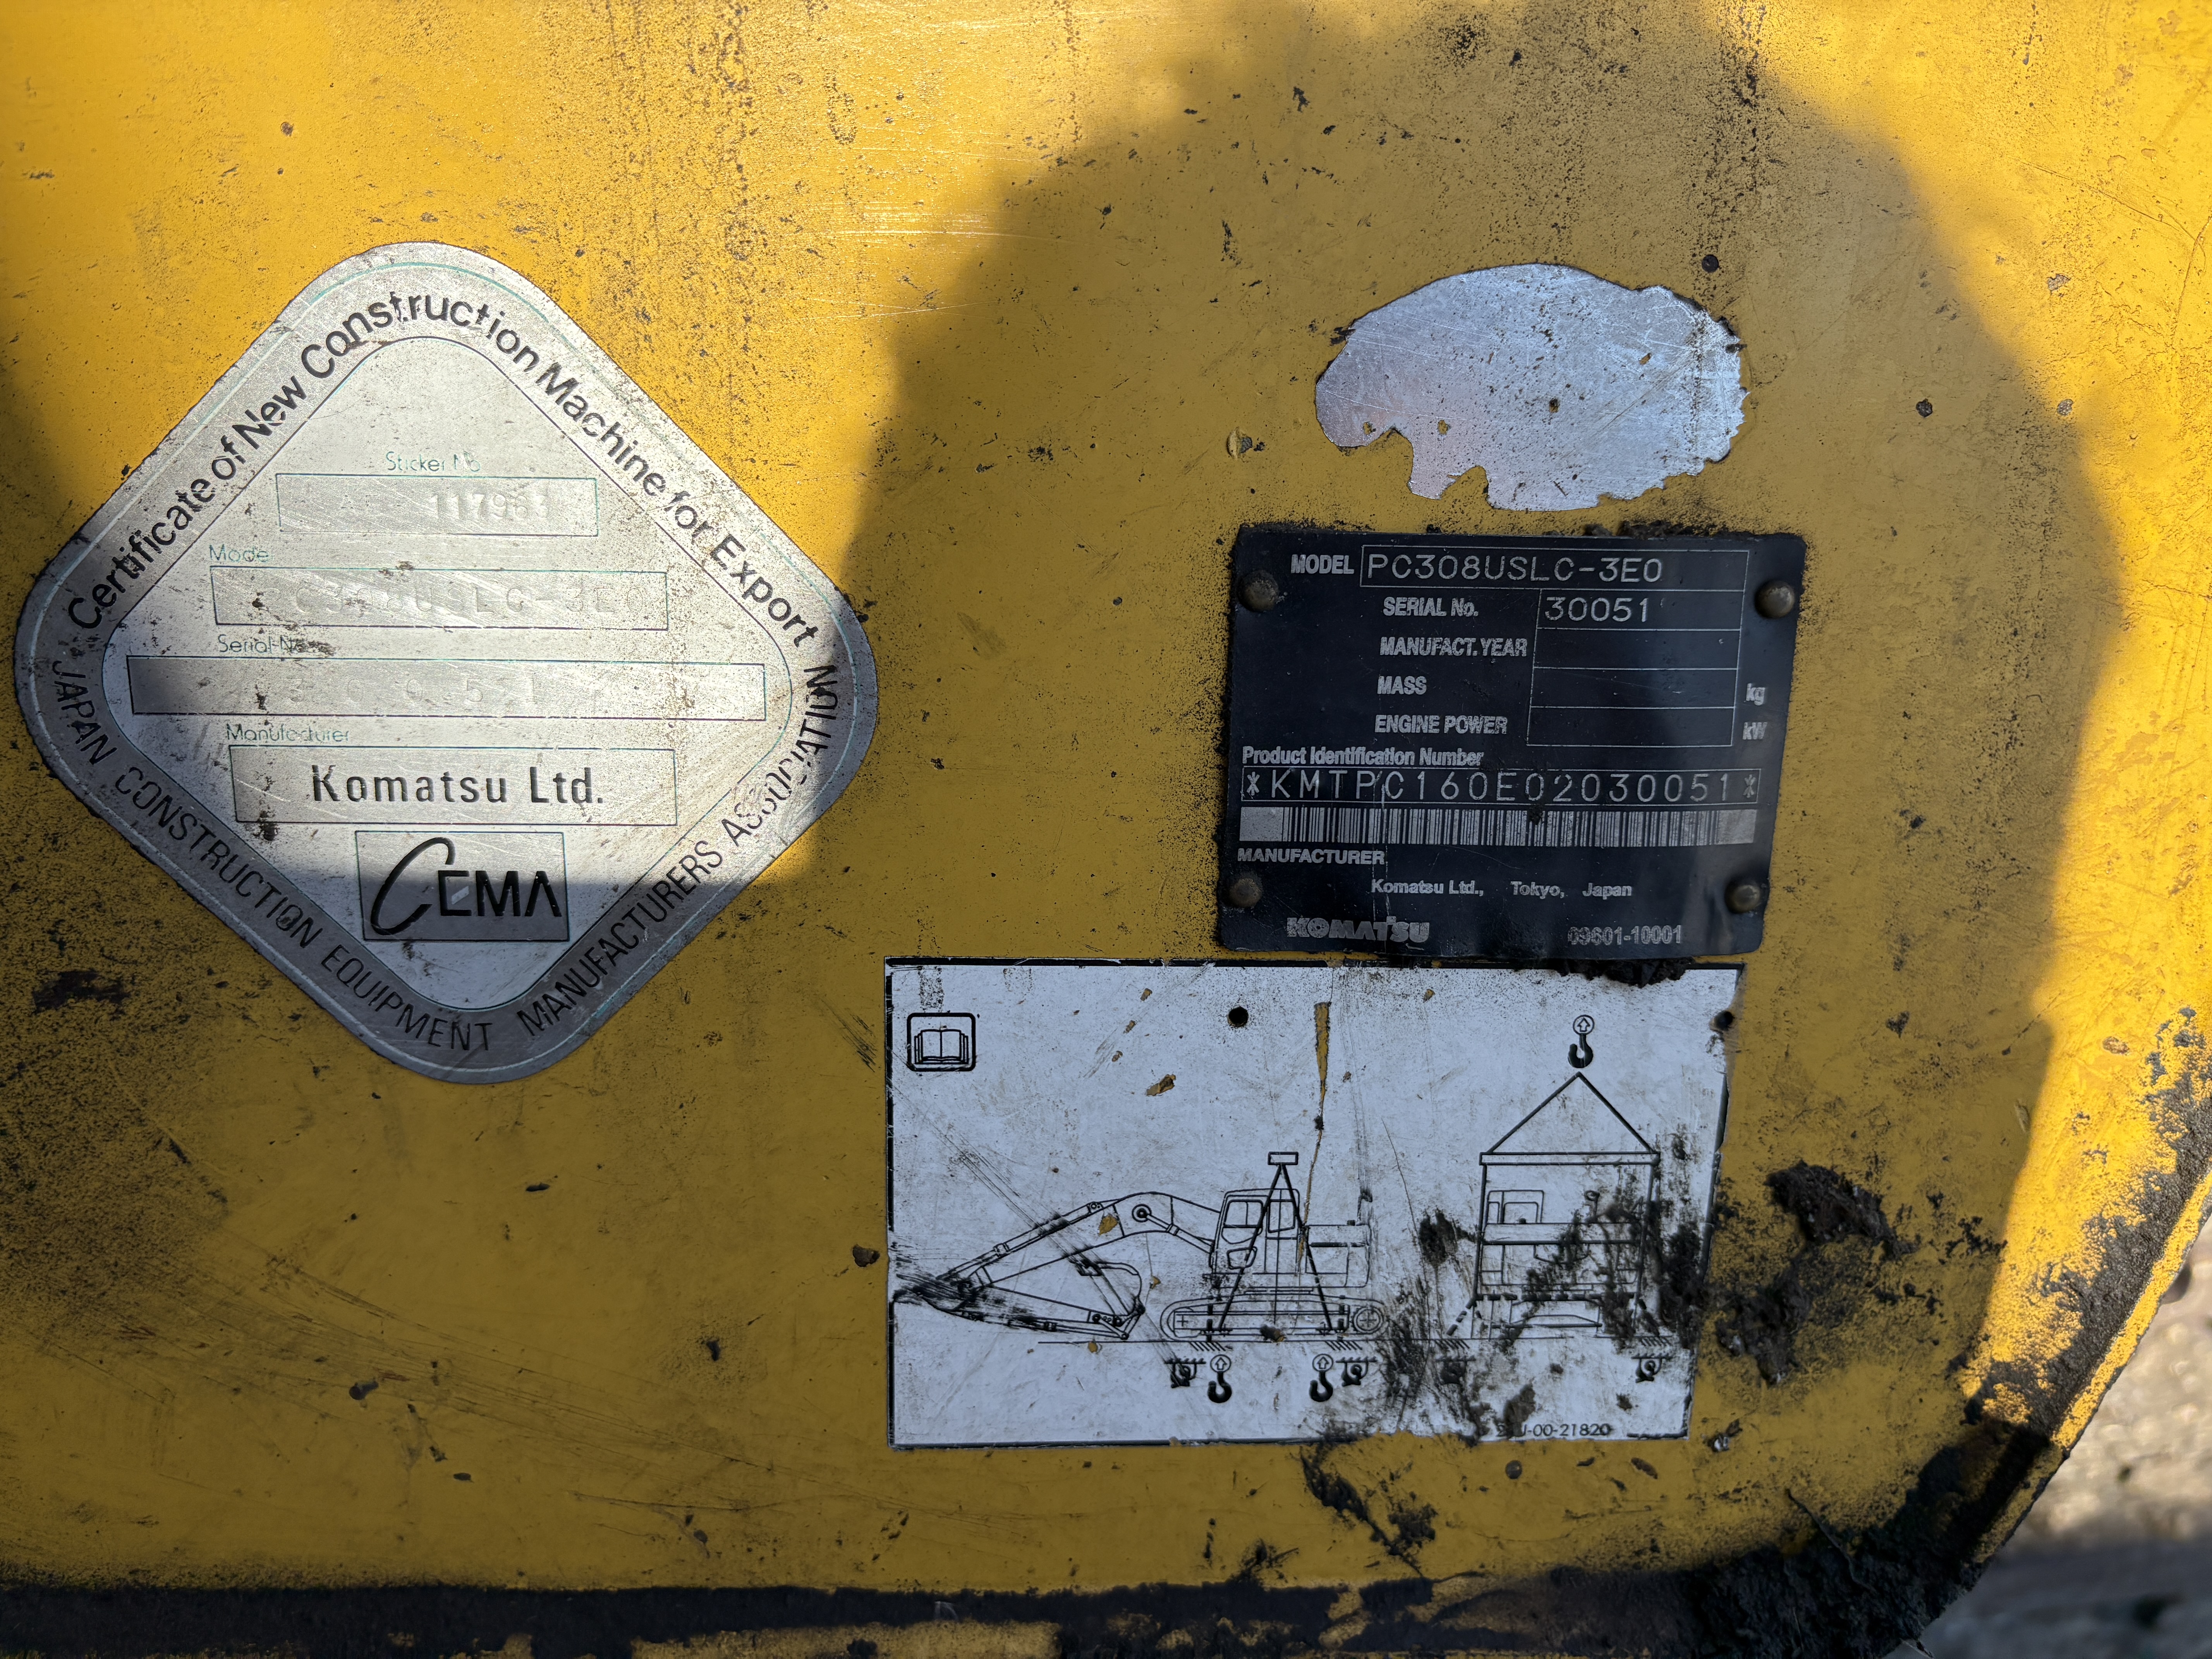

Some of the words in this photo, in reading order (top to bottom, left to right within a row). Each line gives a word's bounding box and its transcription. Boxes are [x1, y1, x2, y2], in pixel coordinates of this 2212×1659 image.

[68, 478, 215, 629] Certificate
[212, 434, 246, 480] of
[232, 376, 307, 449] New
[301, 291, 540, 378] Construction
[536, 362, 666, 496] Machine
[664, 491, 714, 544] for
[709, 534, 819, 647] Export
[386, 451, 445, 472] Sticker
[1291, 554, 1355, 574] MODEL
[1367, 554, 1662, 582] PC308USLC-3E0
[1383, 597, 1447, 617] SERIAL
[1451, 598, 1479, 617] No.
[1544, 597, 1649, 622] 30051
[1377, 676, 1427, 695] MASS
[1746, 683, 1765, 706] kg
[1375, 714, 1439, 733] ENGINE
[1444, 715, 1508, 734] POWER
[1743, 722, 1768, 740] kW
[1242, 746, 1307, 764] Product
[1310, 746, 1415, 765] Identification
[1419, 747, 1484, 766] Number
[312, 764, 507, 802] Komatsu
[529, 766, 604, 804] Ltd.
[52, 660, 117, 765] JAPAN
[115, 767, 323, 948] CONSTRUCTION
[321, 944, 493, 1051] EQUIPMENT
[516, 840, 723, 1037] MANUFACTURERS
[1237, 848, 1385, 865] MANUFACTURER
[1371, 879, 1444, 894] Komatsu
[1449, 880, 1484, 896] Ltd.,
[1510, 881, 1565, 899] Tokyo,
[1582, 883, 1632, 900] Japan
[1287, 916, 1430, 943] KOMATSU
